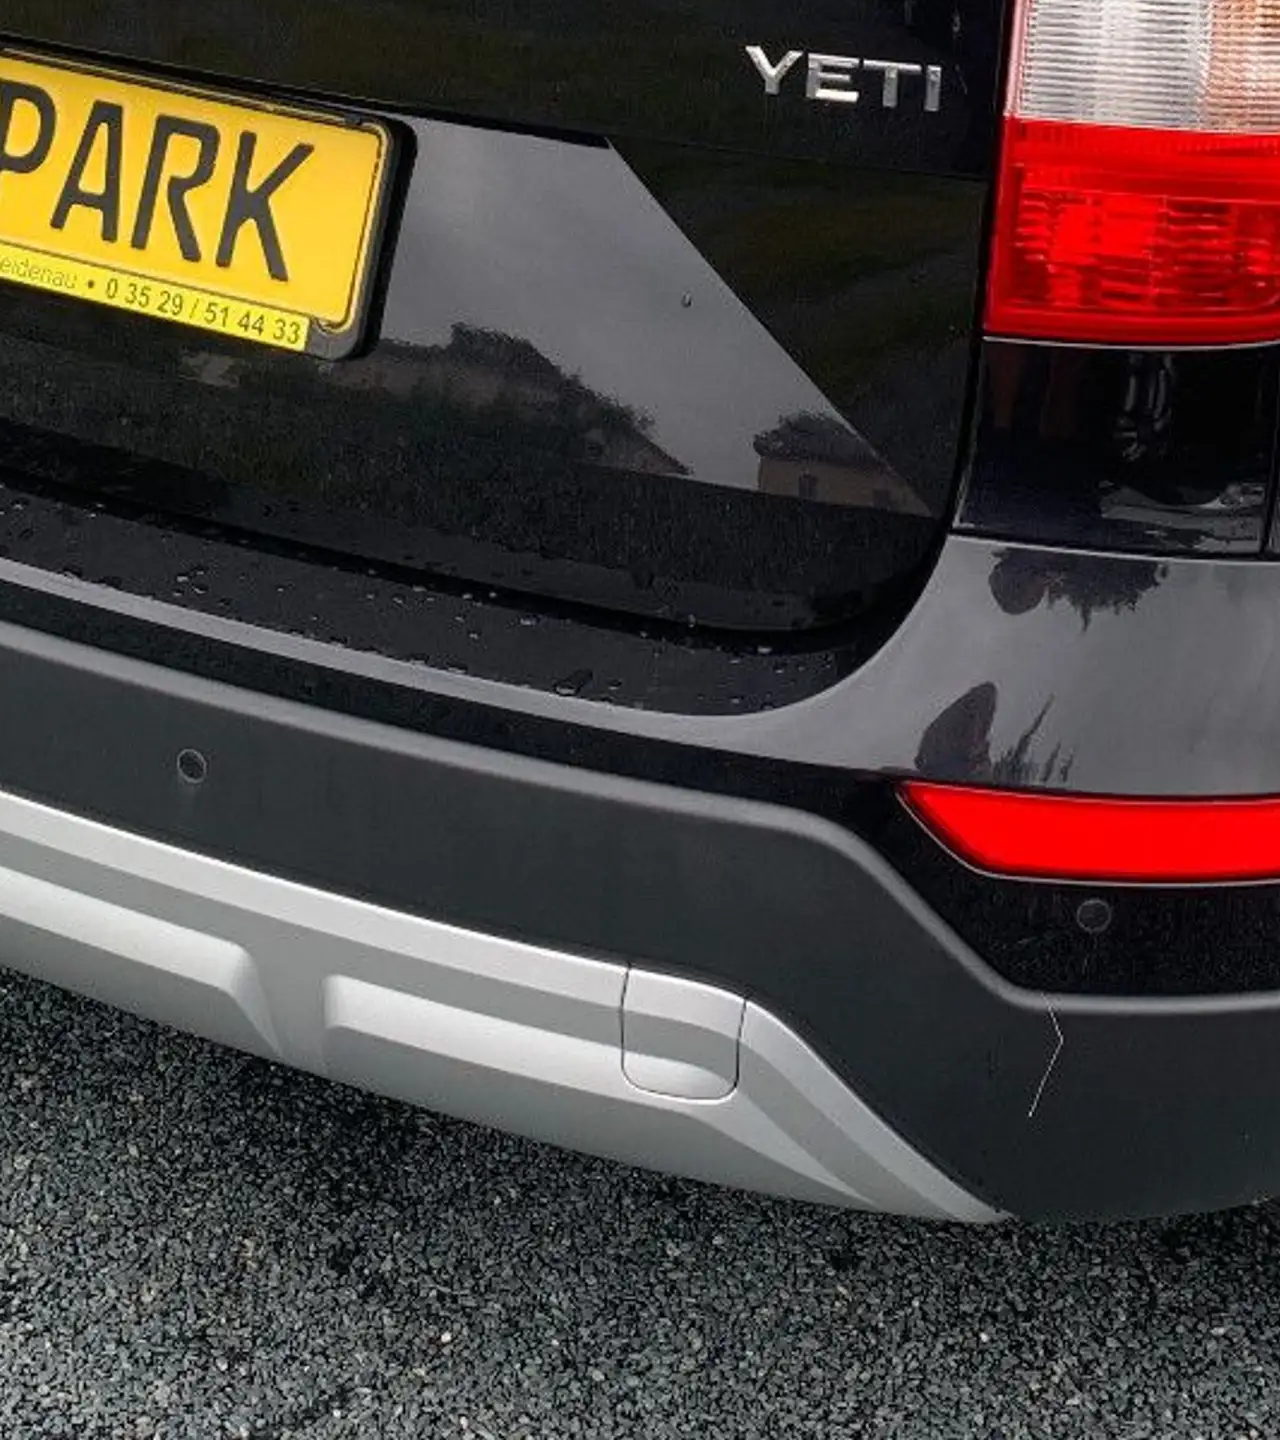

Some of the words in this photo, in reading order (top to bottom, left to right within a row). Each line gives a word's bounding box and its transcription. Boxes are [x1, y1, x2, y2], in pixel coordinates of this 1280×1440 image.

[744, 45, 942, 111] YETI
[104, 276, 119, 300] 0
[124, 282, 152, 309] 35
[156, 289, 185, 317] 29
[203, 301, 229, 328] 51
[237, 311, 265, 337] 44
[272, 317, 303, 346] 33
